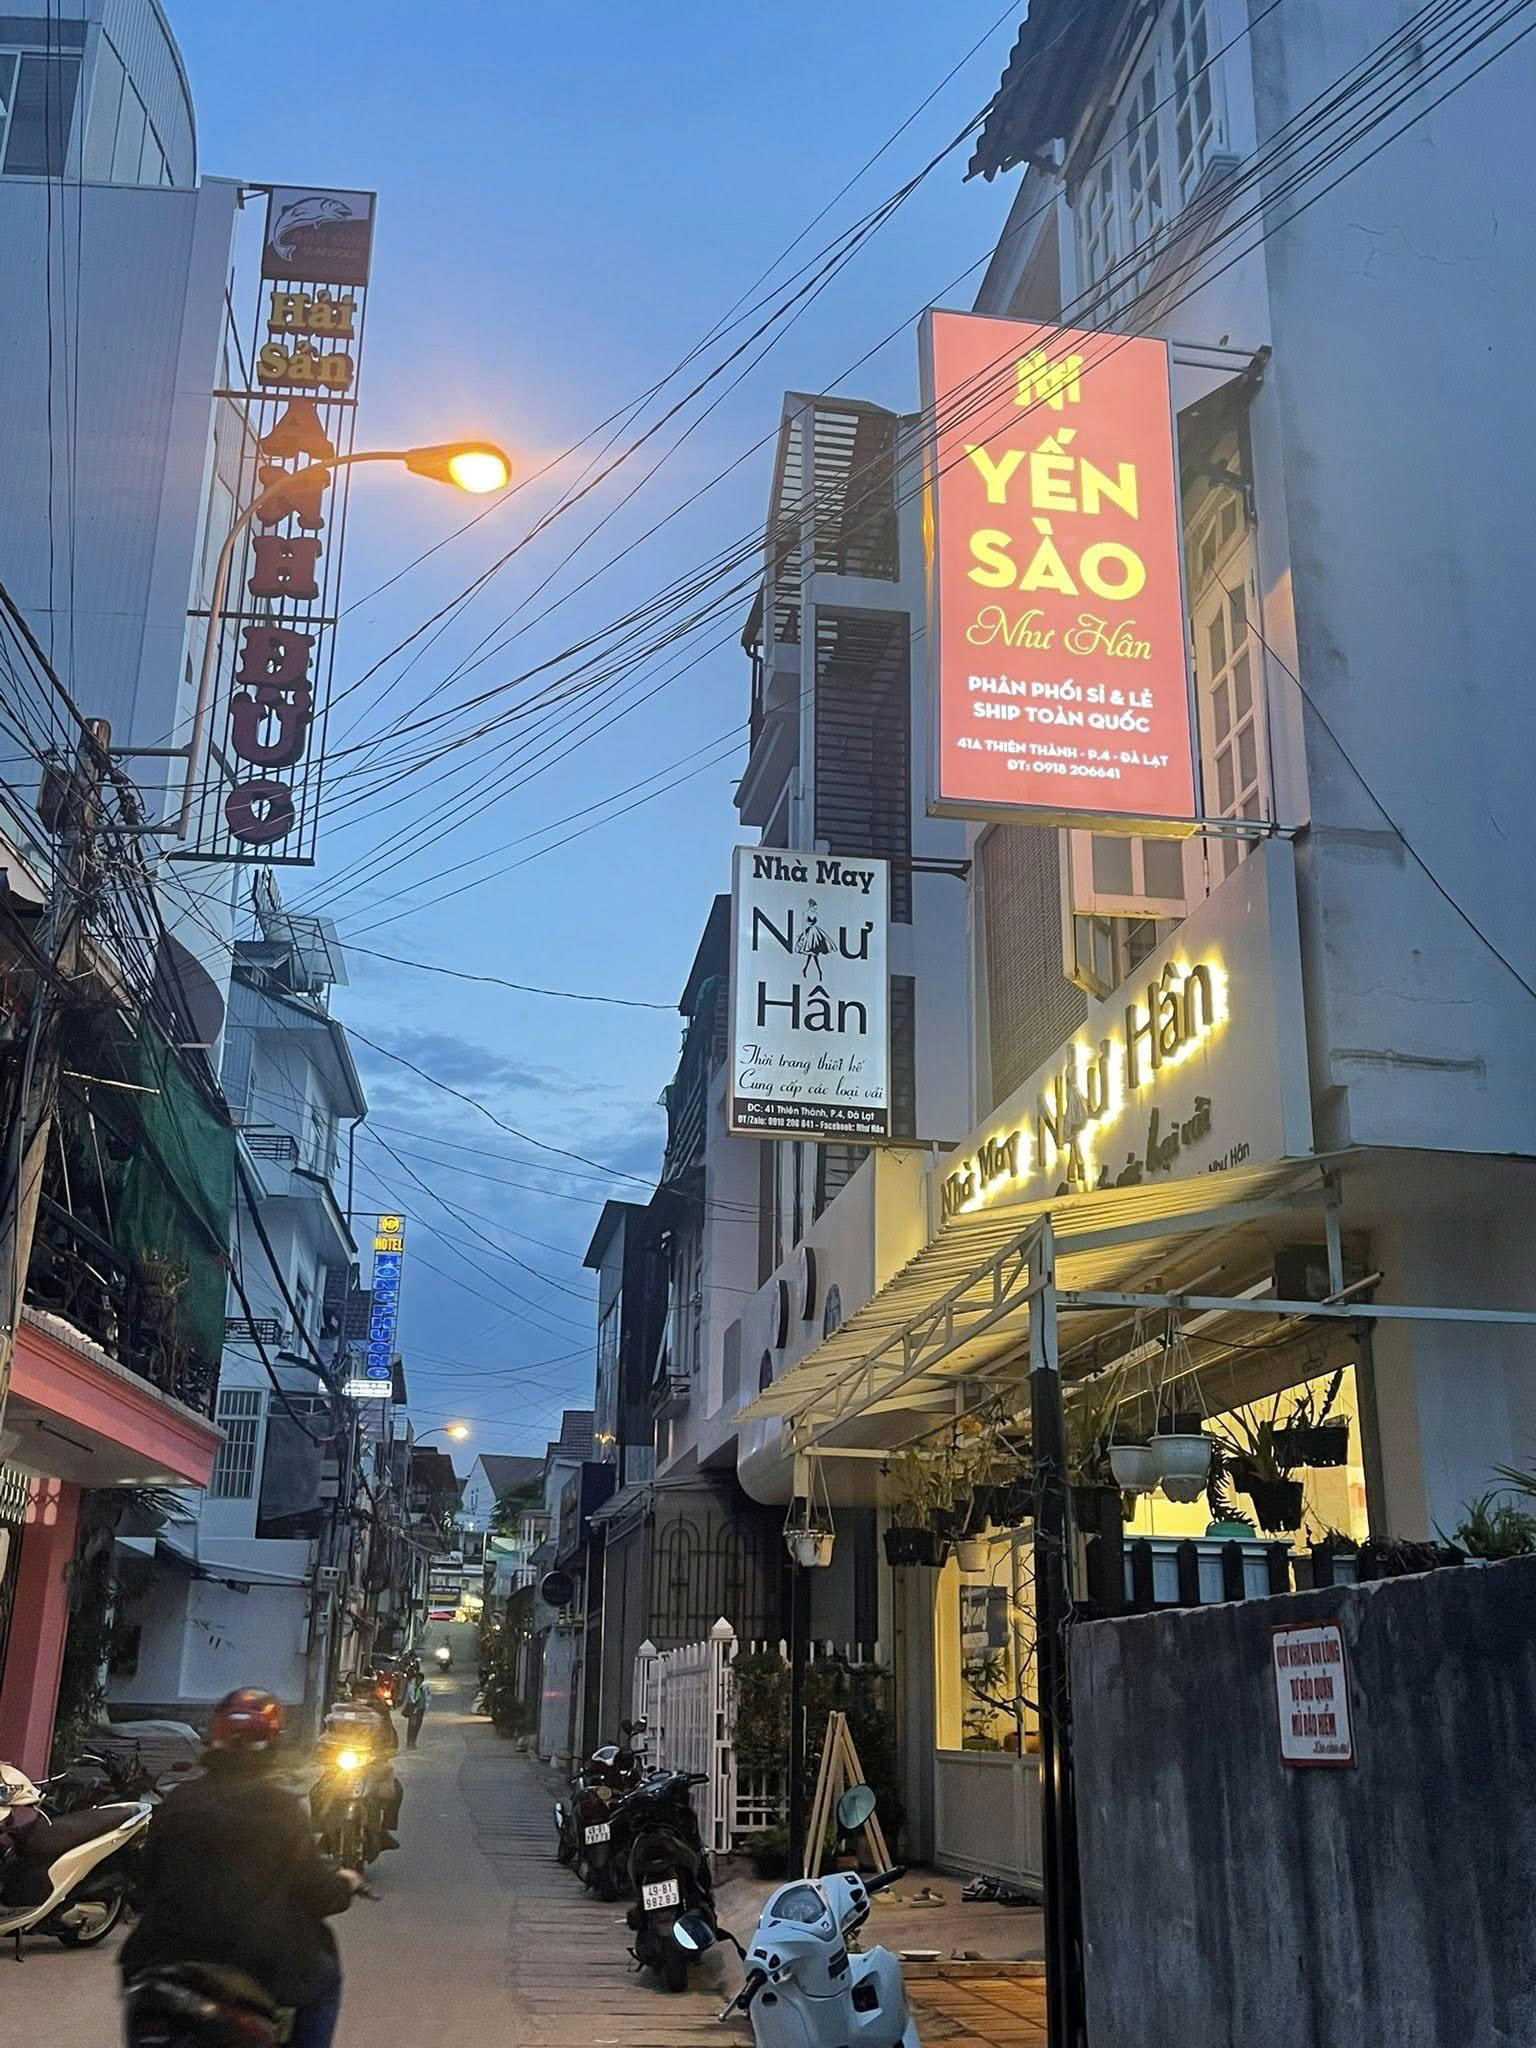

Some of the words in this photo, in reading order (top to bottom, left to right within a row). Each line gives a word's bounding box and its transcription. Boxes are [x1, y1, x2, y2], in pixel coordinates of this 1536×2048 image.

[268, 289, 357, 340] Hải
[257, 340, 354, 392] Sản
[964, 428, 1138, 520] YẾN
[967, 517, 1146, 600] SÀO
[1064, 613, 1152, 659] Hân
[968, 674, 1027, 697] PHÂN
[1031, 678, 1083, 702] PHỐI
[1109, 689, 1125, 706] &
[973, 701, 1021, 721] SHIP
[1024, 704, 1084, 727] TOÀN
[1087, 708, 1150, 733] QUỐC
[984, 738, 1026, 754] THIÊN
[1028, 742, 1078, 759] THÀNH
[1143, 754, 1169, 769] LẠT
[753, 855, 808, 884] Nhà
[816, 860, 875, 894] May
[757, 982, 868, 1036] Hân
[1126, 961, 1214, 1090] Hân
[739, 1068, 774, 1097] Cung
[780, 1080, 802, 1098] cấp
[808, 1083, 829, 1095] các
[836, 1076, 859, 1099] loại
[779, 1054, 811, 1075] trang
[940, 1161, 976, 1224] Nhà
[977, 1130, 1022, 1187] May
[374, 1237, 403, 1252] HOTEL
